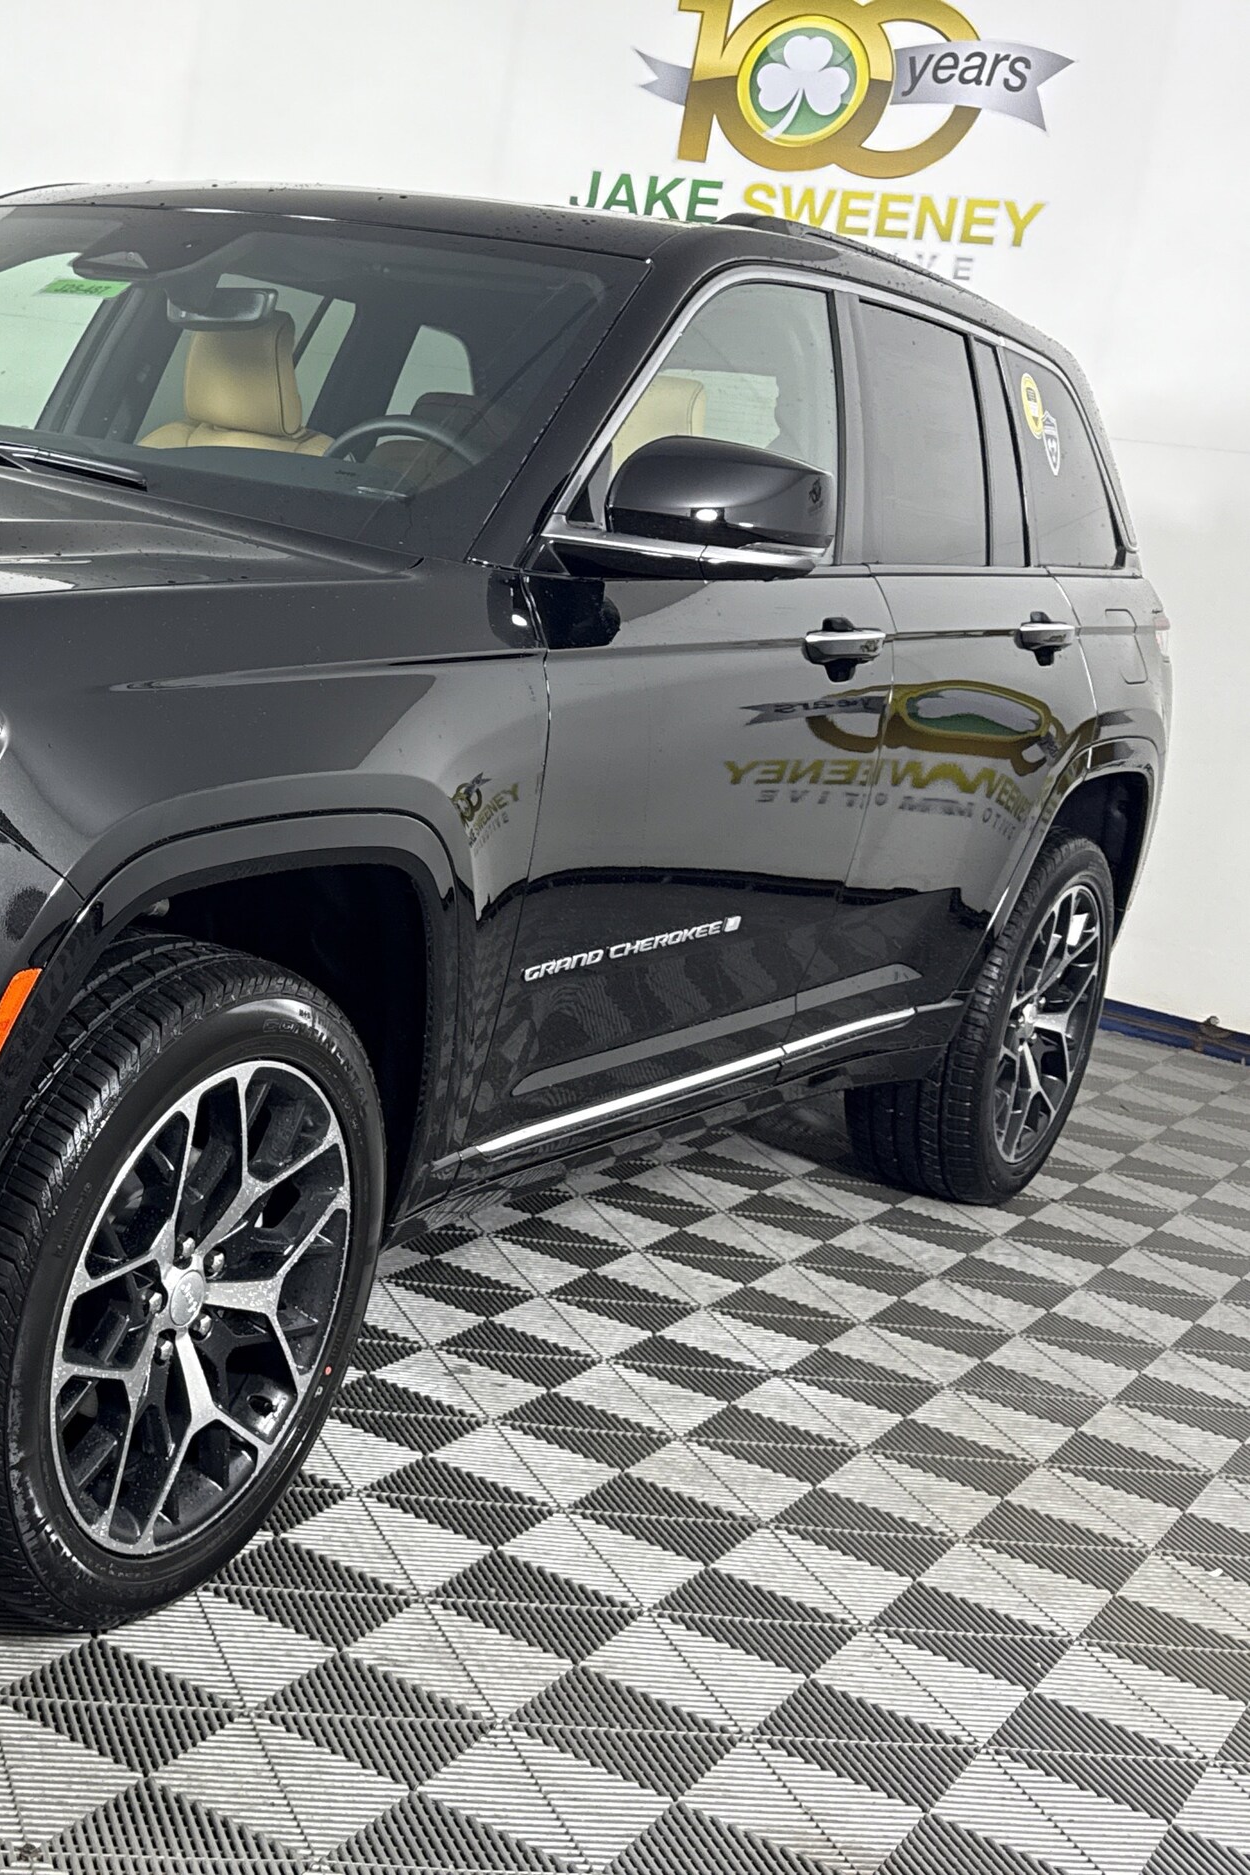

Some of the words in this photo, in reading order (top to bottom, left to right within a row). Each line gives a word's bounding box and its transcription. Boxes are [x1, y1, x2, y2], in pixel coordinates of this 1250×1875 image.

[902, 50, 1032, 98] years
[569, 170, 724, 224] JAKE
[743, 182, 1046, 248] SWEENEY
[524, 949, 604, 982] GRAND
[608, 920, 723, 959] CHEROKEE
